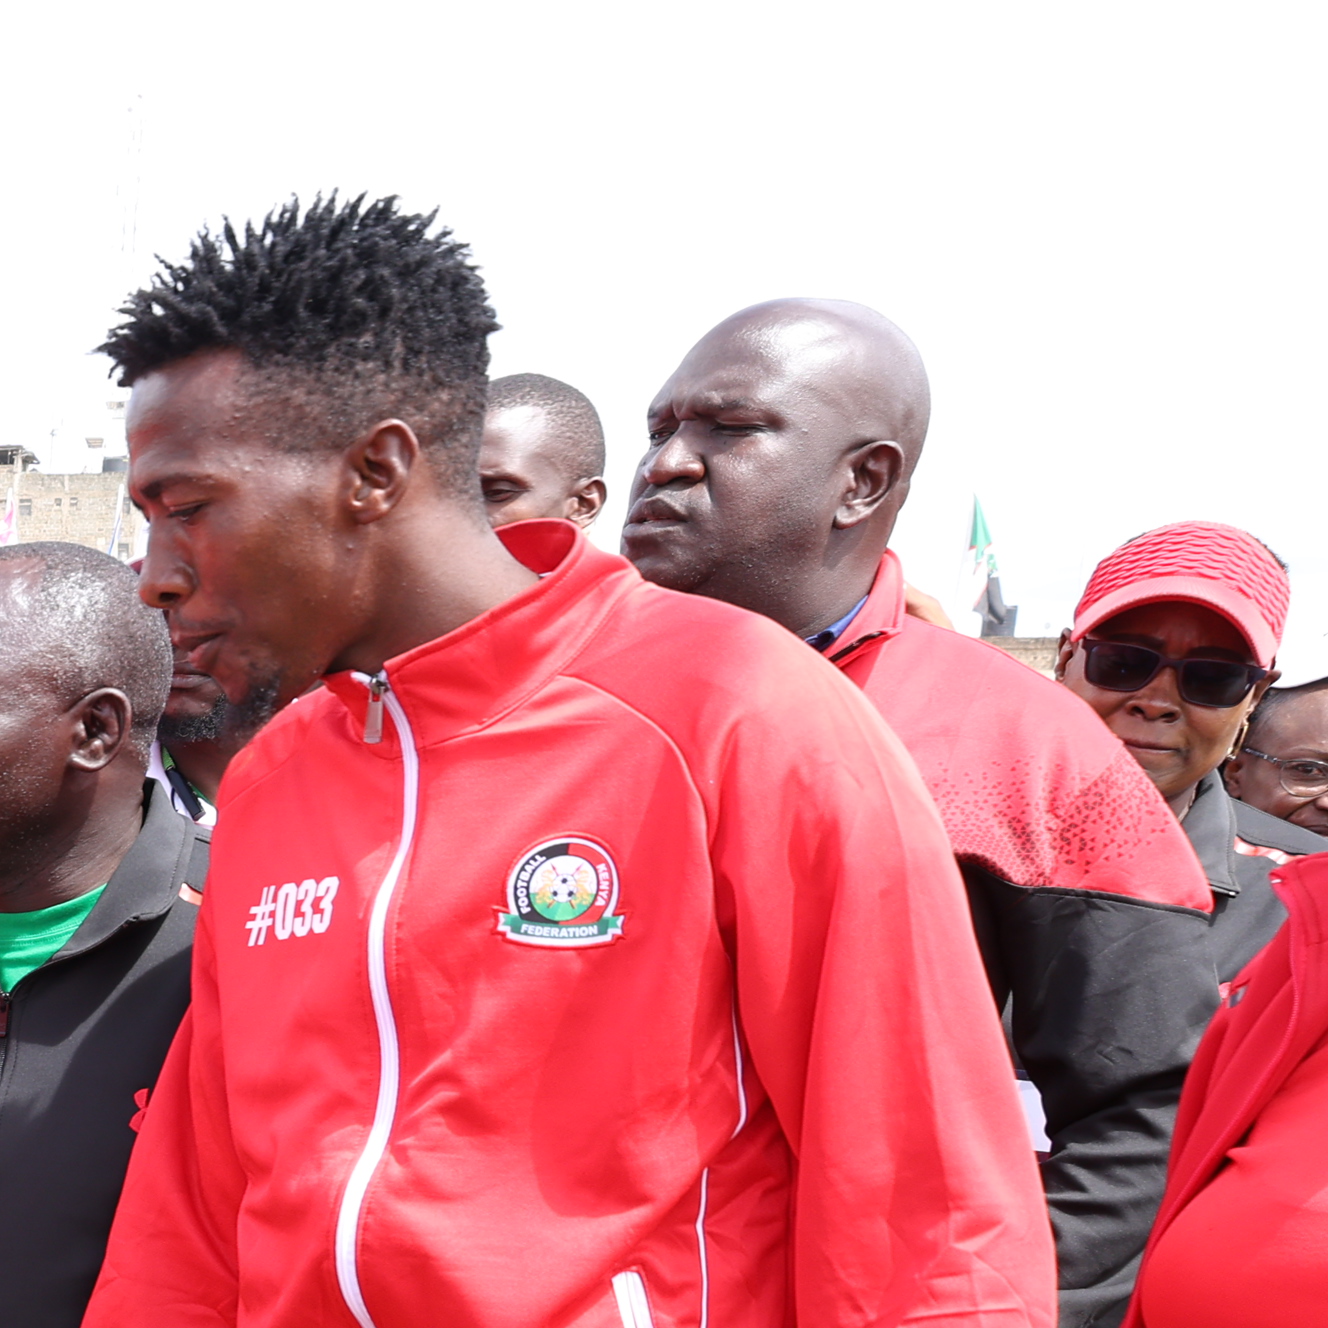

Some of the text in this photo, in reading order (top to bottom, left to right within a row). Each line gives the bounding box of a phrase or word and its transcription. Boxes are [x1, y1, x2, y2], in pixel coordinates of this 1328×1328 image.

[516, 854, 547, 915] FOOTBALL
[594, 863, 610, 907] KENYA
[244, 876, 341, 947] #033
[520, 924, 599, 938] FEDERATION
